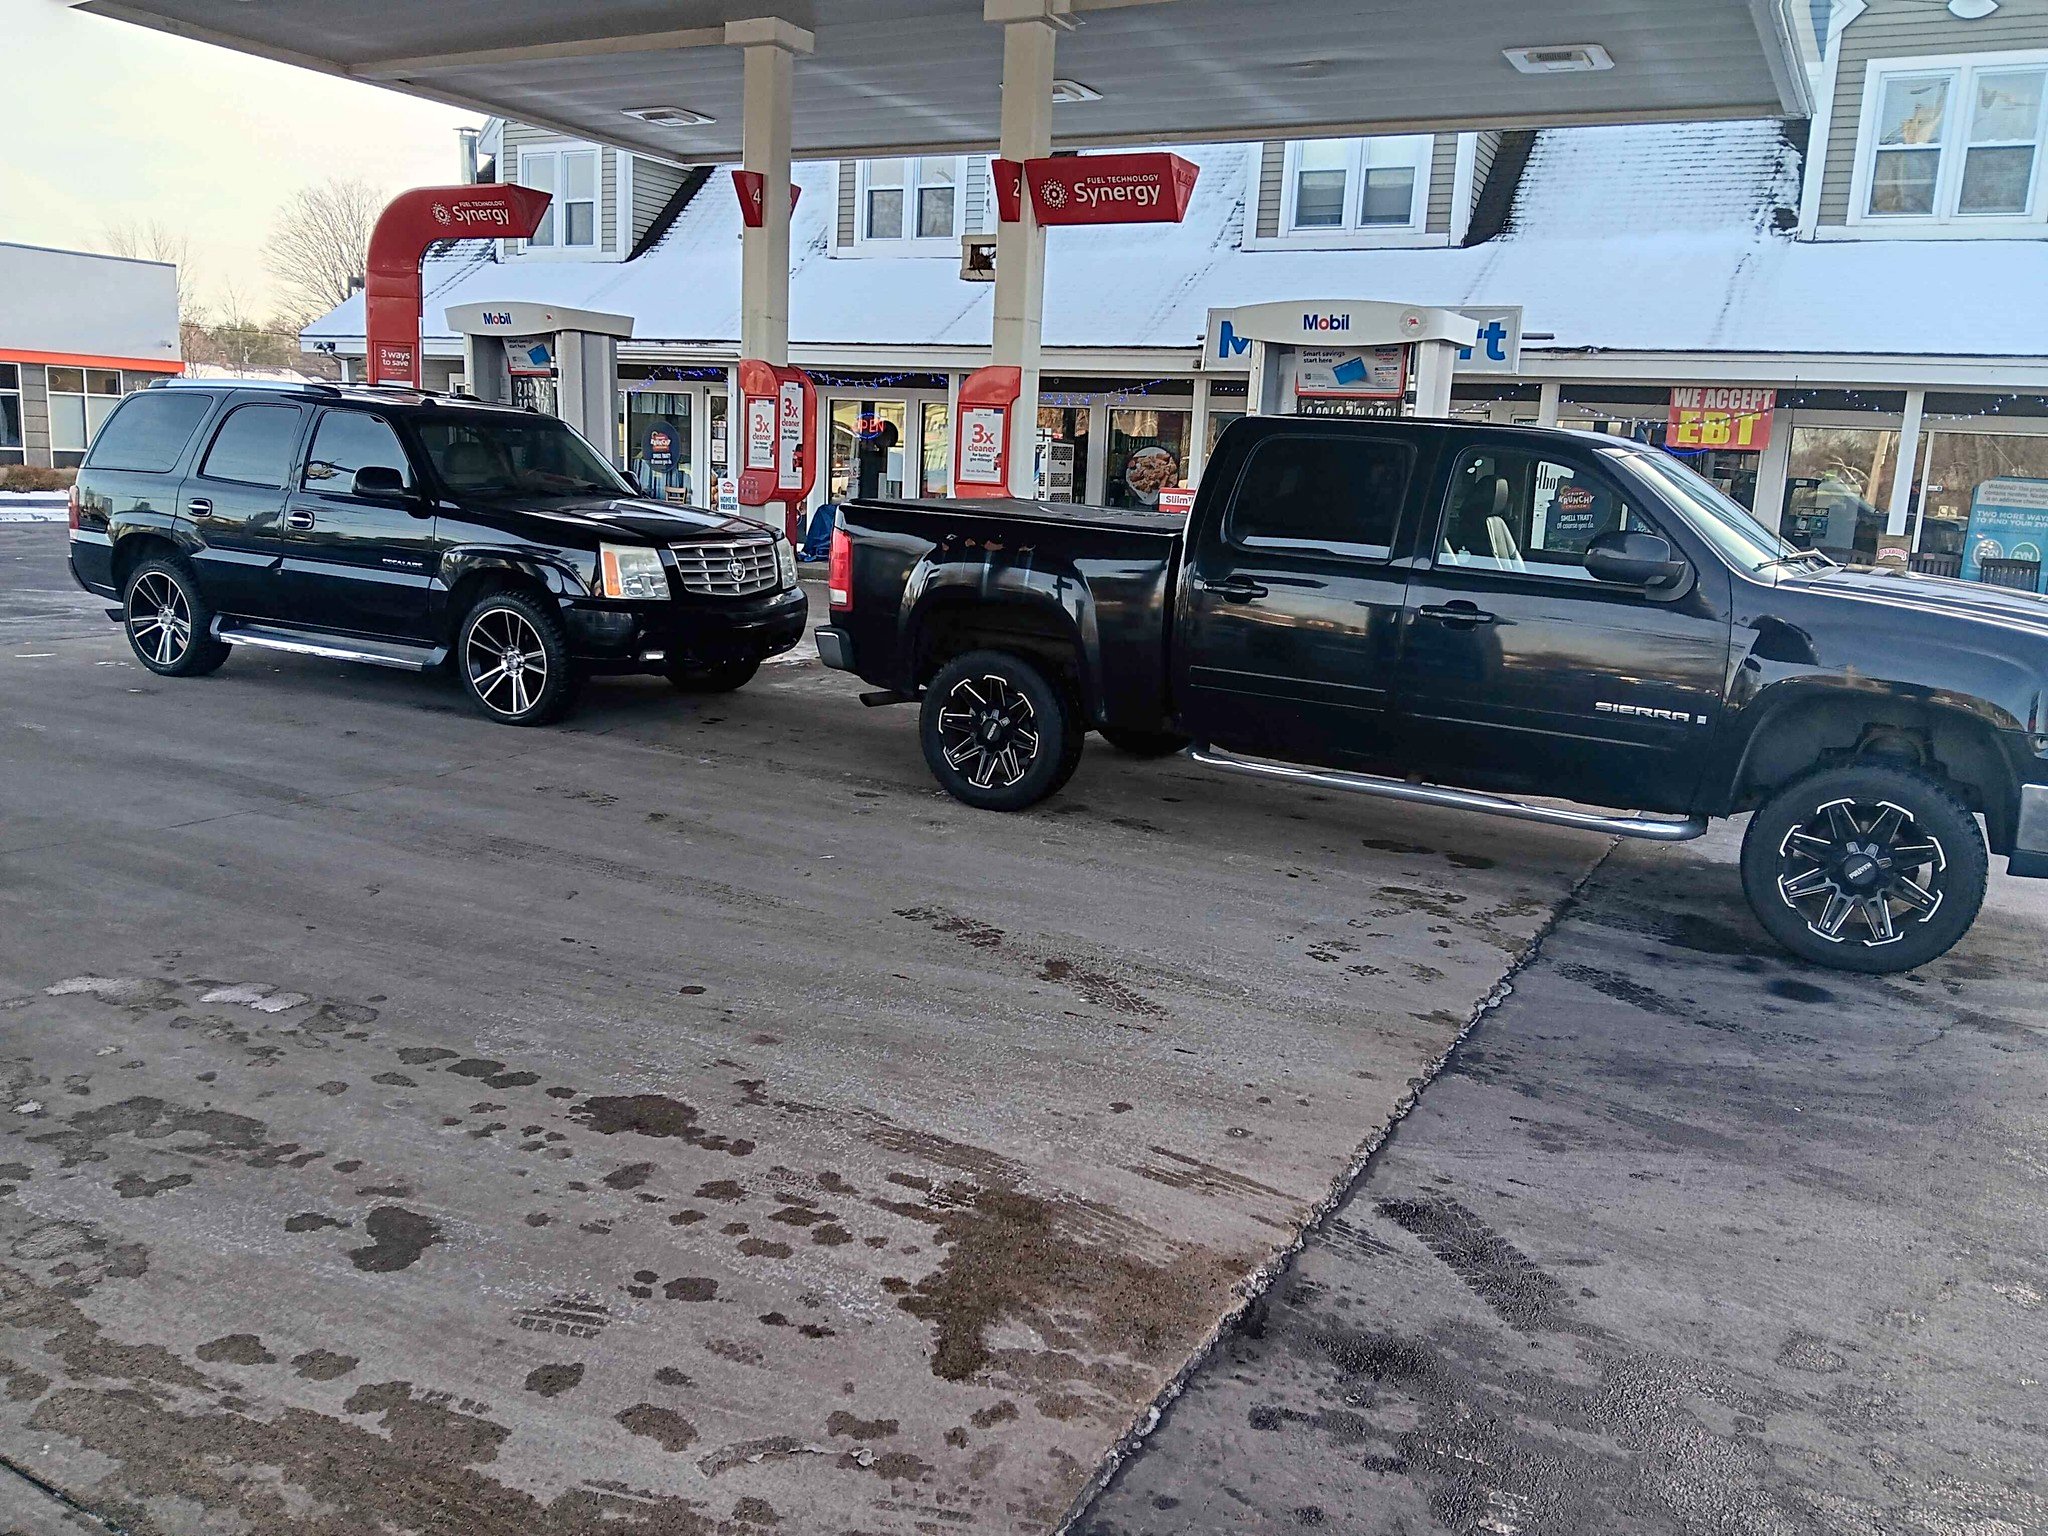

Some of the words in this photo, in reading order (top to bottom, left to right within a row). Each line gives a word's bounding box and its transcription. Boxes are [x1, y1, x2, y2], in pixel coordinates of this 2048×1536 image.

[1087, 175, 1105, 184] FUEL
[1107, 173, 1158, 182] TECHNOLOGY
[753, 188, 761, 204] 4
[1012, 179, 1020, 198] 2
[1074, 182, 1160, 207] Synergy
[452, 205, 509, 225] Synergy
[483, 312, 511, 324] Mobil
[1303, 314, 1349, 330] Mobil
[381, 349, 387, 358] 3
[388, 352, 410, 360] ways
[1674, 388, 1702, 408] WE
[1703, 388, 1773, 410] ACCEPT
[784, 398, 798, 418] 3x
[755, 413, 769, 433] 3x
[781, 418, 800, 427] cleaner
[1677, 411, 1761, 445] EBT
[752, 432, 771, 440] cleaner
[972, 423, 994, 445] 3x
[968, 443, 996, 453] cleaner
[1558, 495, 1595, 505] KRUNCHY
[1977, 510, 1998, 518] TWO
[2014, 551, 2033, 560] ZYN
[1595, 701, 1690, 722] SIERRA
